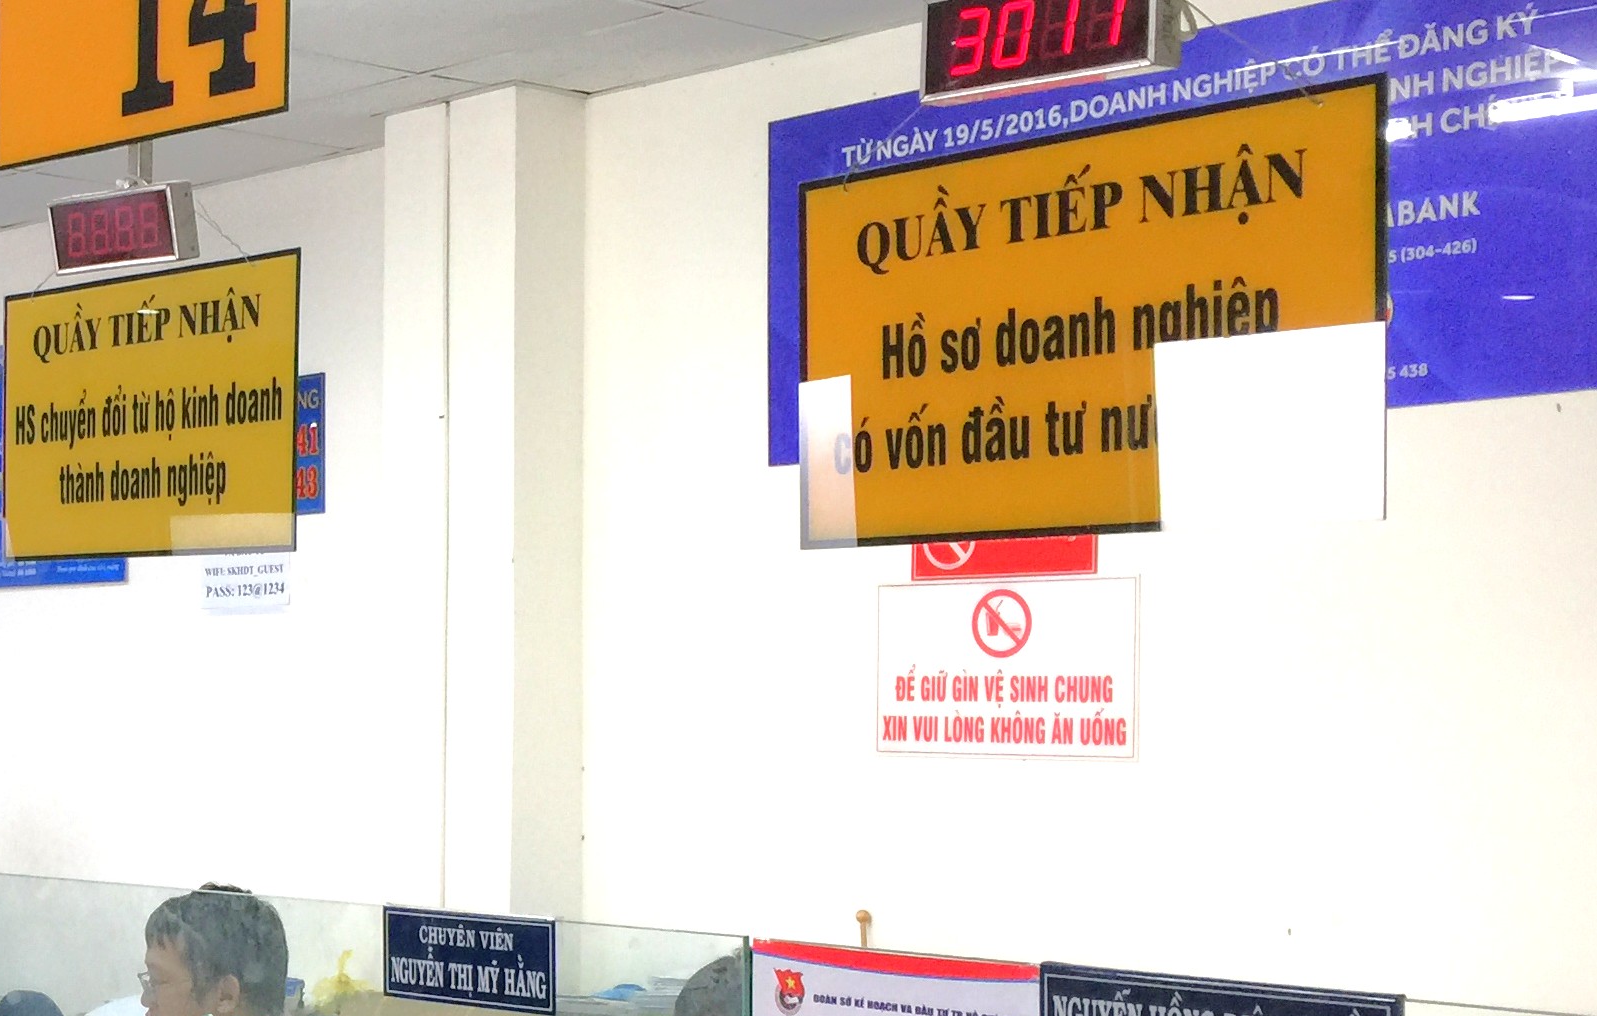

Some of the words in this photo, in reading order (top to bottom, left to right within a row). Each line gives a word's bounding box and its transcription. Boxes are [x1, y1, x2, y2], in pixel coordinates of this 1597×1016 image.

[121, 0, 257, 117] 14
[876, 128, 939, 162] NGÀY
[1171, 57, 1276, 103] NGHIỆP
[1284, 48, 1326, 81] CÓ
[1333, 28, 1392, 72] THỂ
[1397, 17, 1489, 60] ĐĂNG
[1496, 3, 1539, 40] KÝ
[856, 184, 986, 275] QUẦY
[1000, 163, 1124, 245] TIẾP
[1139, 143, 1308, 226] NHẬN
[1400, 237, 1478, 264] (304-426)
[33, 302, 102, 364] QUẦY
[108, 294, 171, 348] TIẾP
[179, 286, 262, 344] NHẬN
[881, 312, 927, 381] Hồ
[940, 316, 982, 374] sơ
[995, 296, 1116, 368] doanh
[15, 403, 36, 446] HS
[41, 388, 96, 450] chuyển
[102, 384, 127, 438] đổi
[133, 390, 151, 435] từ
[155, 387, 175, 441] hộ
[181, 383, 219, 430] kinh
[225, 376, 283, 427] doanh
[834, 416, 873, 476] có
[885, 402, 947, 470] vốn
[961, 395, 1031, 465] đầu
[1045, 400, 1088, 457] tư
[59, 461, 105, 505] thành
[110, 457, 161, 501] doanh
[167, 451, 227, 507] nghiệp
[205, 585, 235, 599] PASS:
[237, 581, 286, 599] 123@1234
[895, 664, 917, 702] ĐỂ
[920, 670, 948, 703] GIỮ
[954, 668, 979, 703] GÌN
[984, 668, 1005, 709] VỆ
[1009, 675, 1049, 703] SINH
[1054, 675, 1114, 704] CHUNG
[882, 715, 908, 742] XIN
[912, 715, 939, 743] VUI
[943, 709, 985, 744] LÒNG
[990, 709, 1047, 745] KHÔNG
[1051, 711, 1074, 745] ĂN
[1079, 708, 1128, 746] UỐNG
[418, 924, 476, 949] CHUYÊN
[479, 926, 515, 952] VIÊN
[390, 946, 445, 989] NGUYỄN
[447, 961, 474, 999] THỊ
[504, 953, 547, 1000] HẰNG
